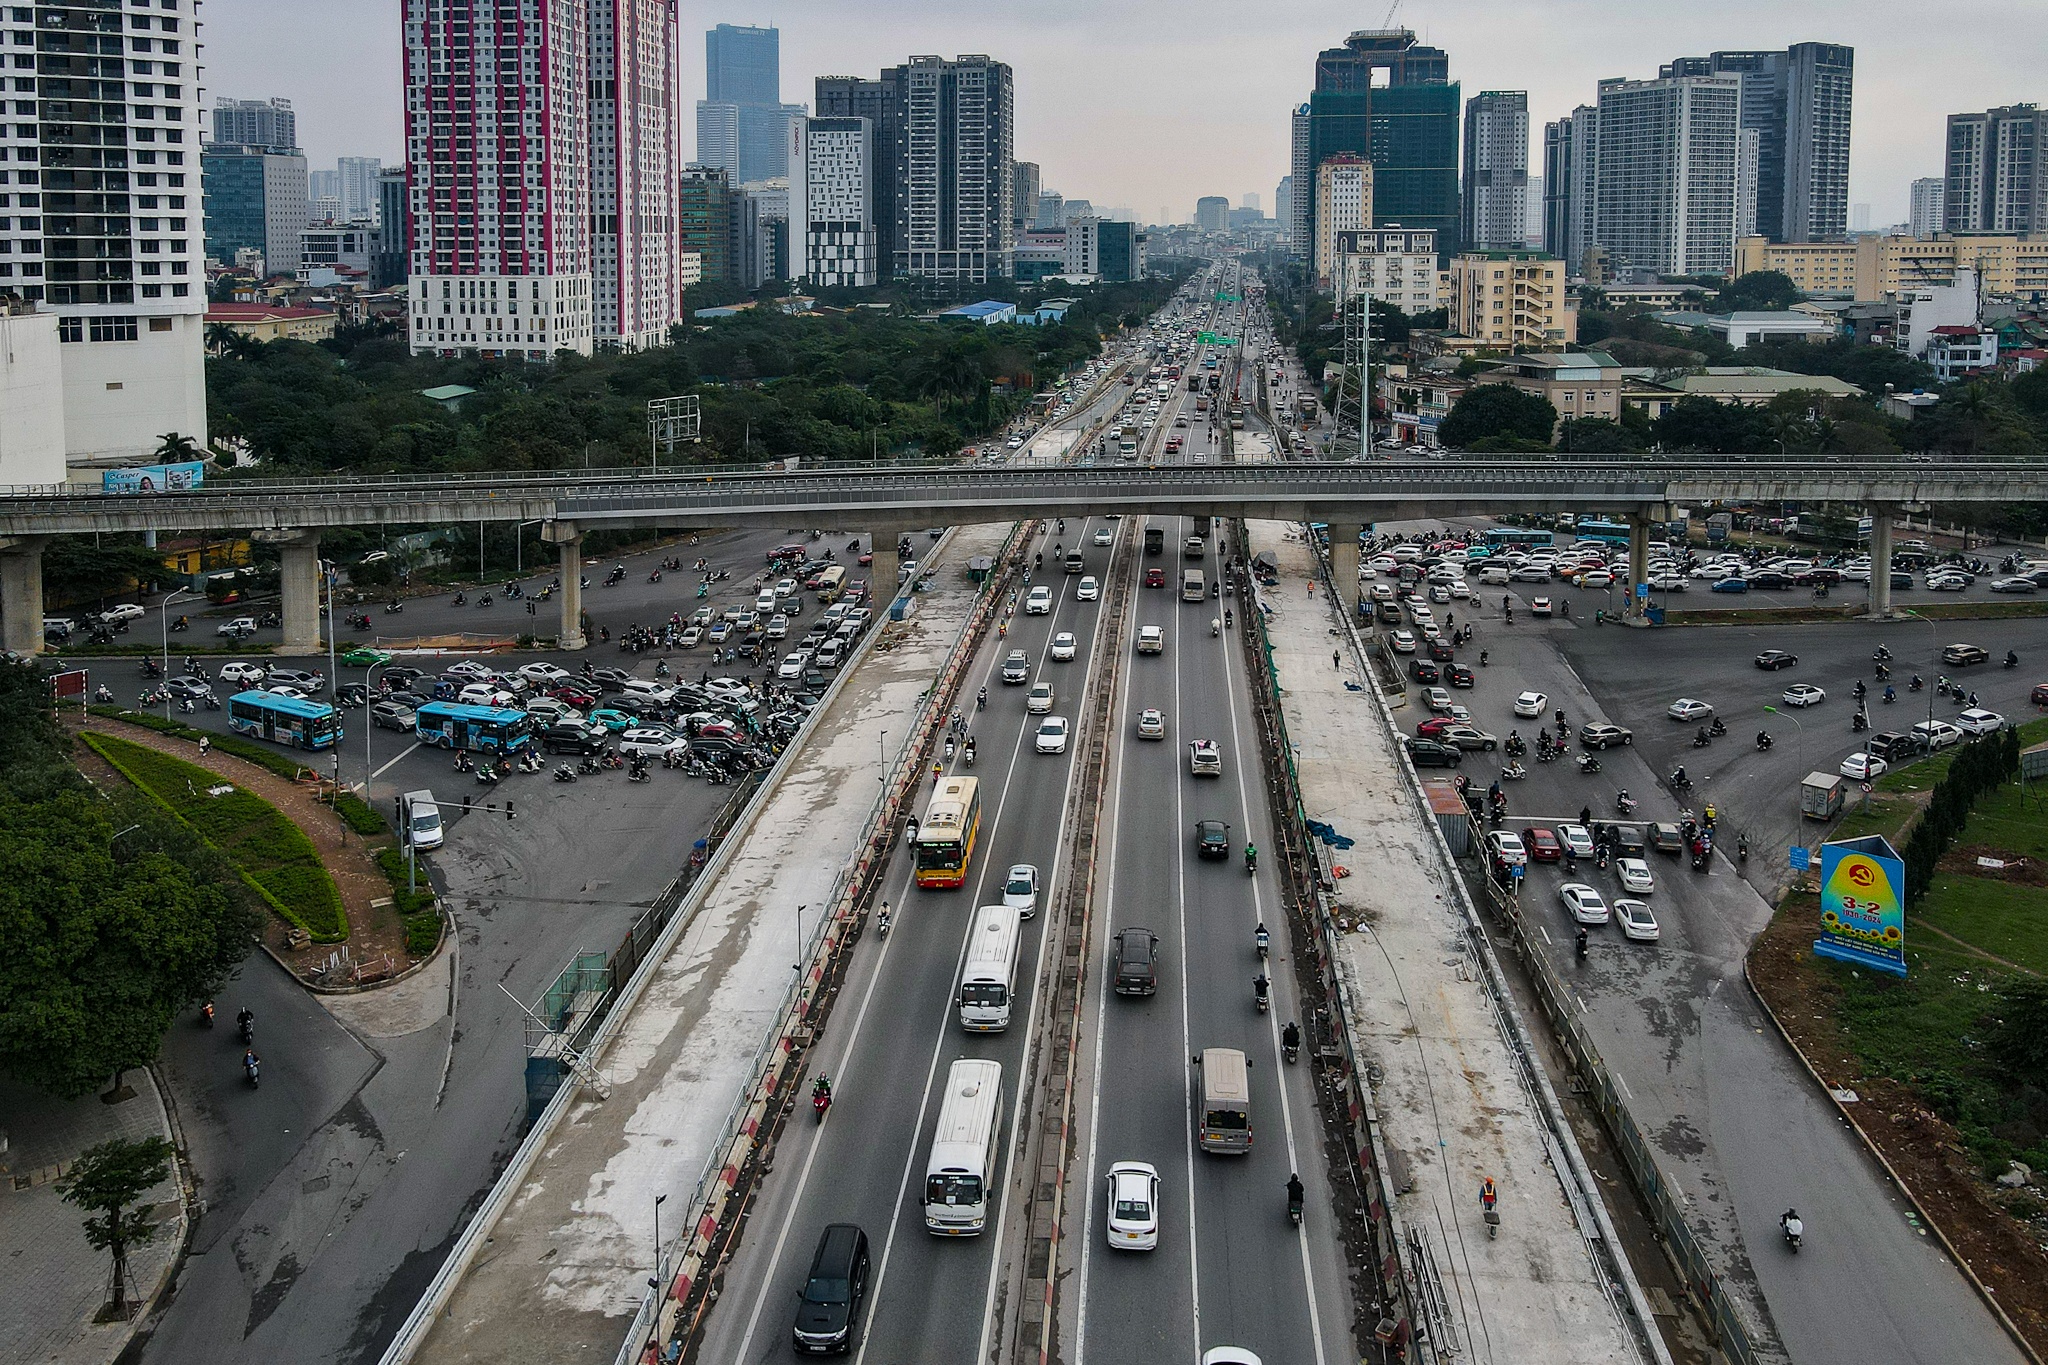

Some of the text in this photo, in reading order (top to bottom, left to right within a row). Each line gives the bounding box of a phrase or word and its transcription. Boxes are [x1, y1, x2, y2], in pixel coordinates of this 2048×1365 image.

[115, 472, 140, 480] Casper
[1842, 895, 1881, 916] 3-2
[1842, 909, 1883, 925] 1930-2024
